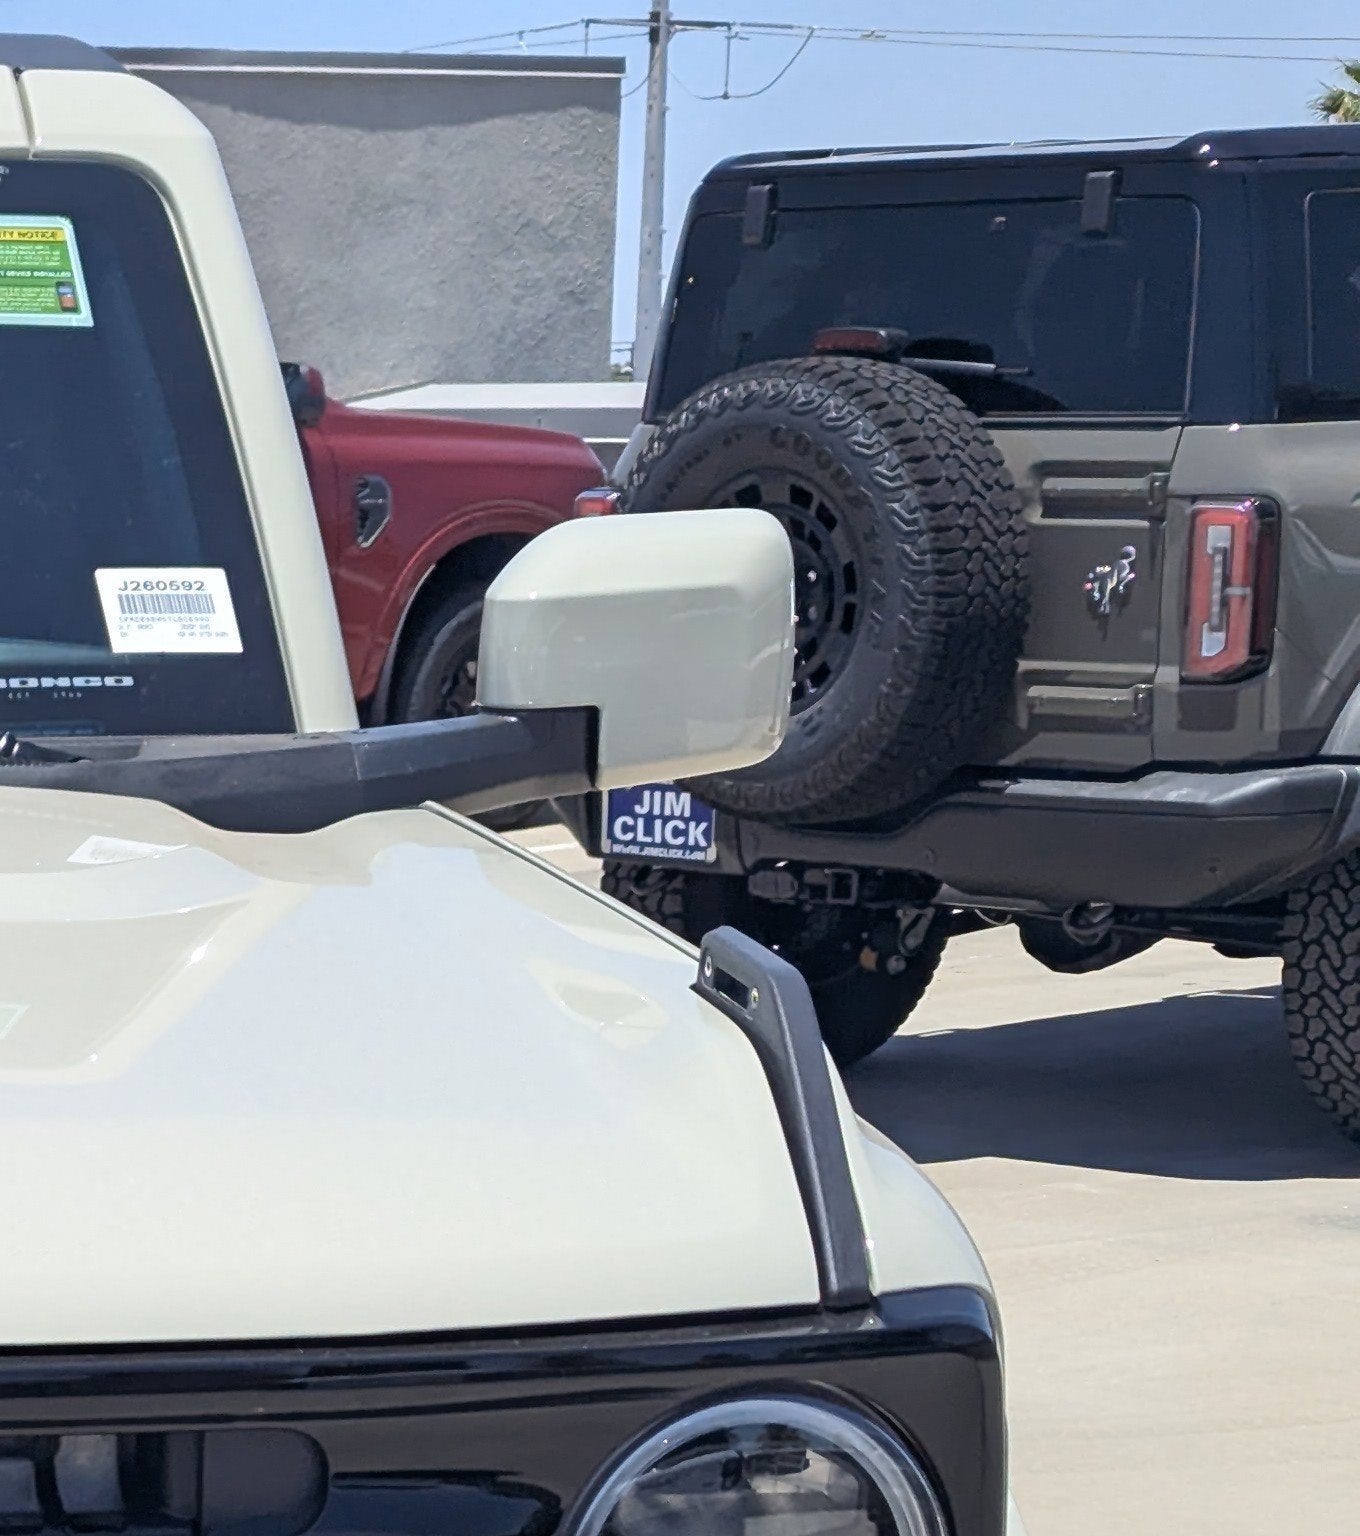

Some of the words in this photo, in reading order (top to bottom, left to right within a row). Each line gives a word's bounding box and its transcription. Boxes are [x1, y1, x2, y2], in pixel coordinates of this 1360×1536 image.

[118, 580, 206, 592] J260592
[634, 790, 691, 818] JIM
[613, 816, 709, 847] CLICK
